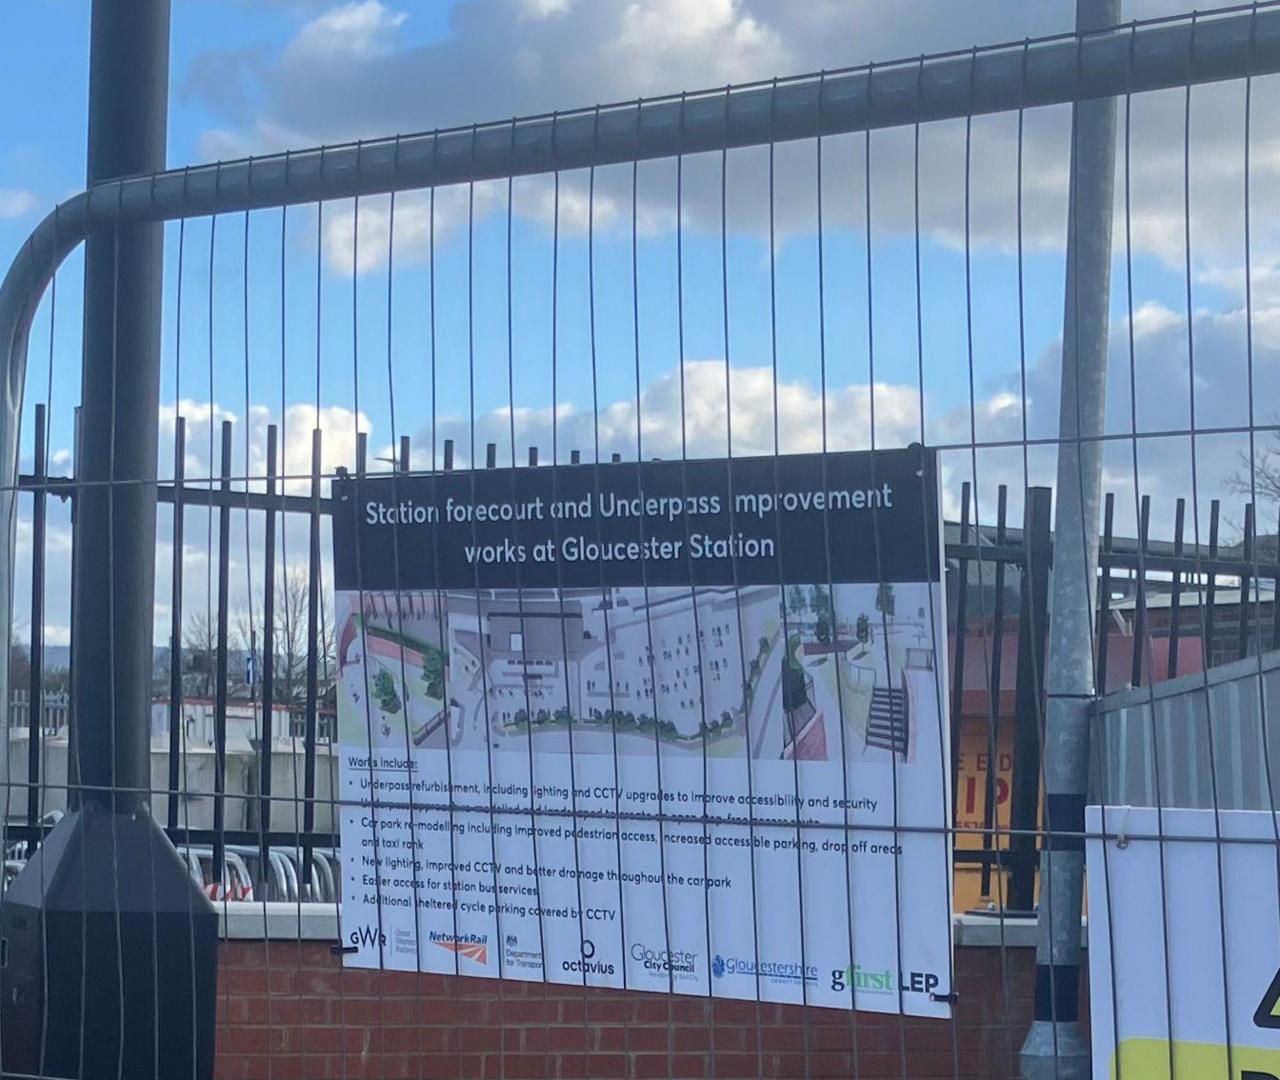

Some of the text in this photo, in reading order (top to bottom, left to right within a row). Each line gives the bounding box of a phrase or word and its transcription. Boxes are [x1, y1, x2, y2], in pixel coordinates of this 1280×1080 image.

[366, 499, 440, 525] Station
[446, 497, 544, 523] forecourt
[550, 493, 592, 519] and
[599, 490, 721, 522] Underpass
[464, 533, 775, 563] works at Gloucester Station
[677, 790, 689, 801] to
[808, 795, 830, 808] and
[381, 817, 402, 831] park
[621, 831, 658, 844] access,
[852, 840, 869, 853] off
[382, 838, 400, 849] taxi
[504, 864, 524, 876] and
[667, 873, 685, 885] the
[427, 878, 440, 890] for
[499, 884, 539, 896] services
[460, 901, 486, 914] cycle
[586, 908, 616, 921] CCTV
